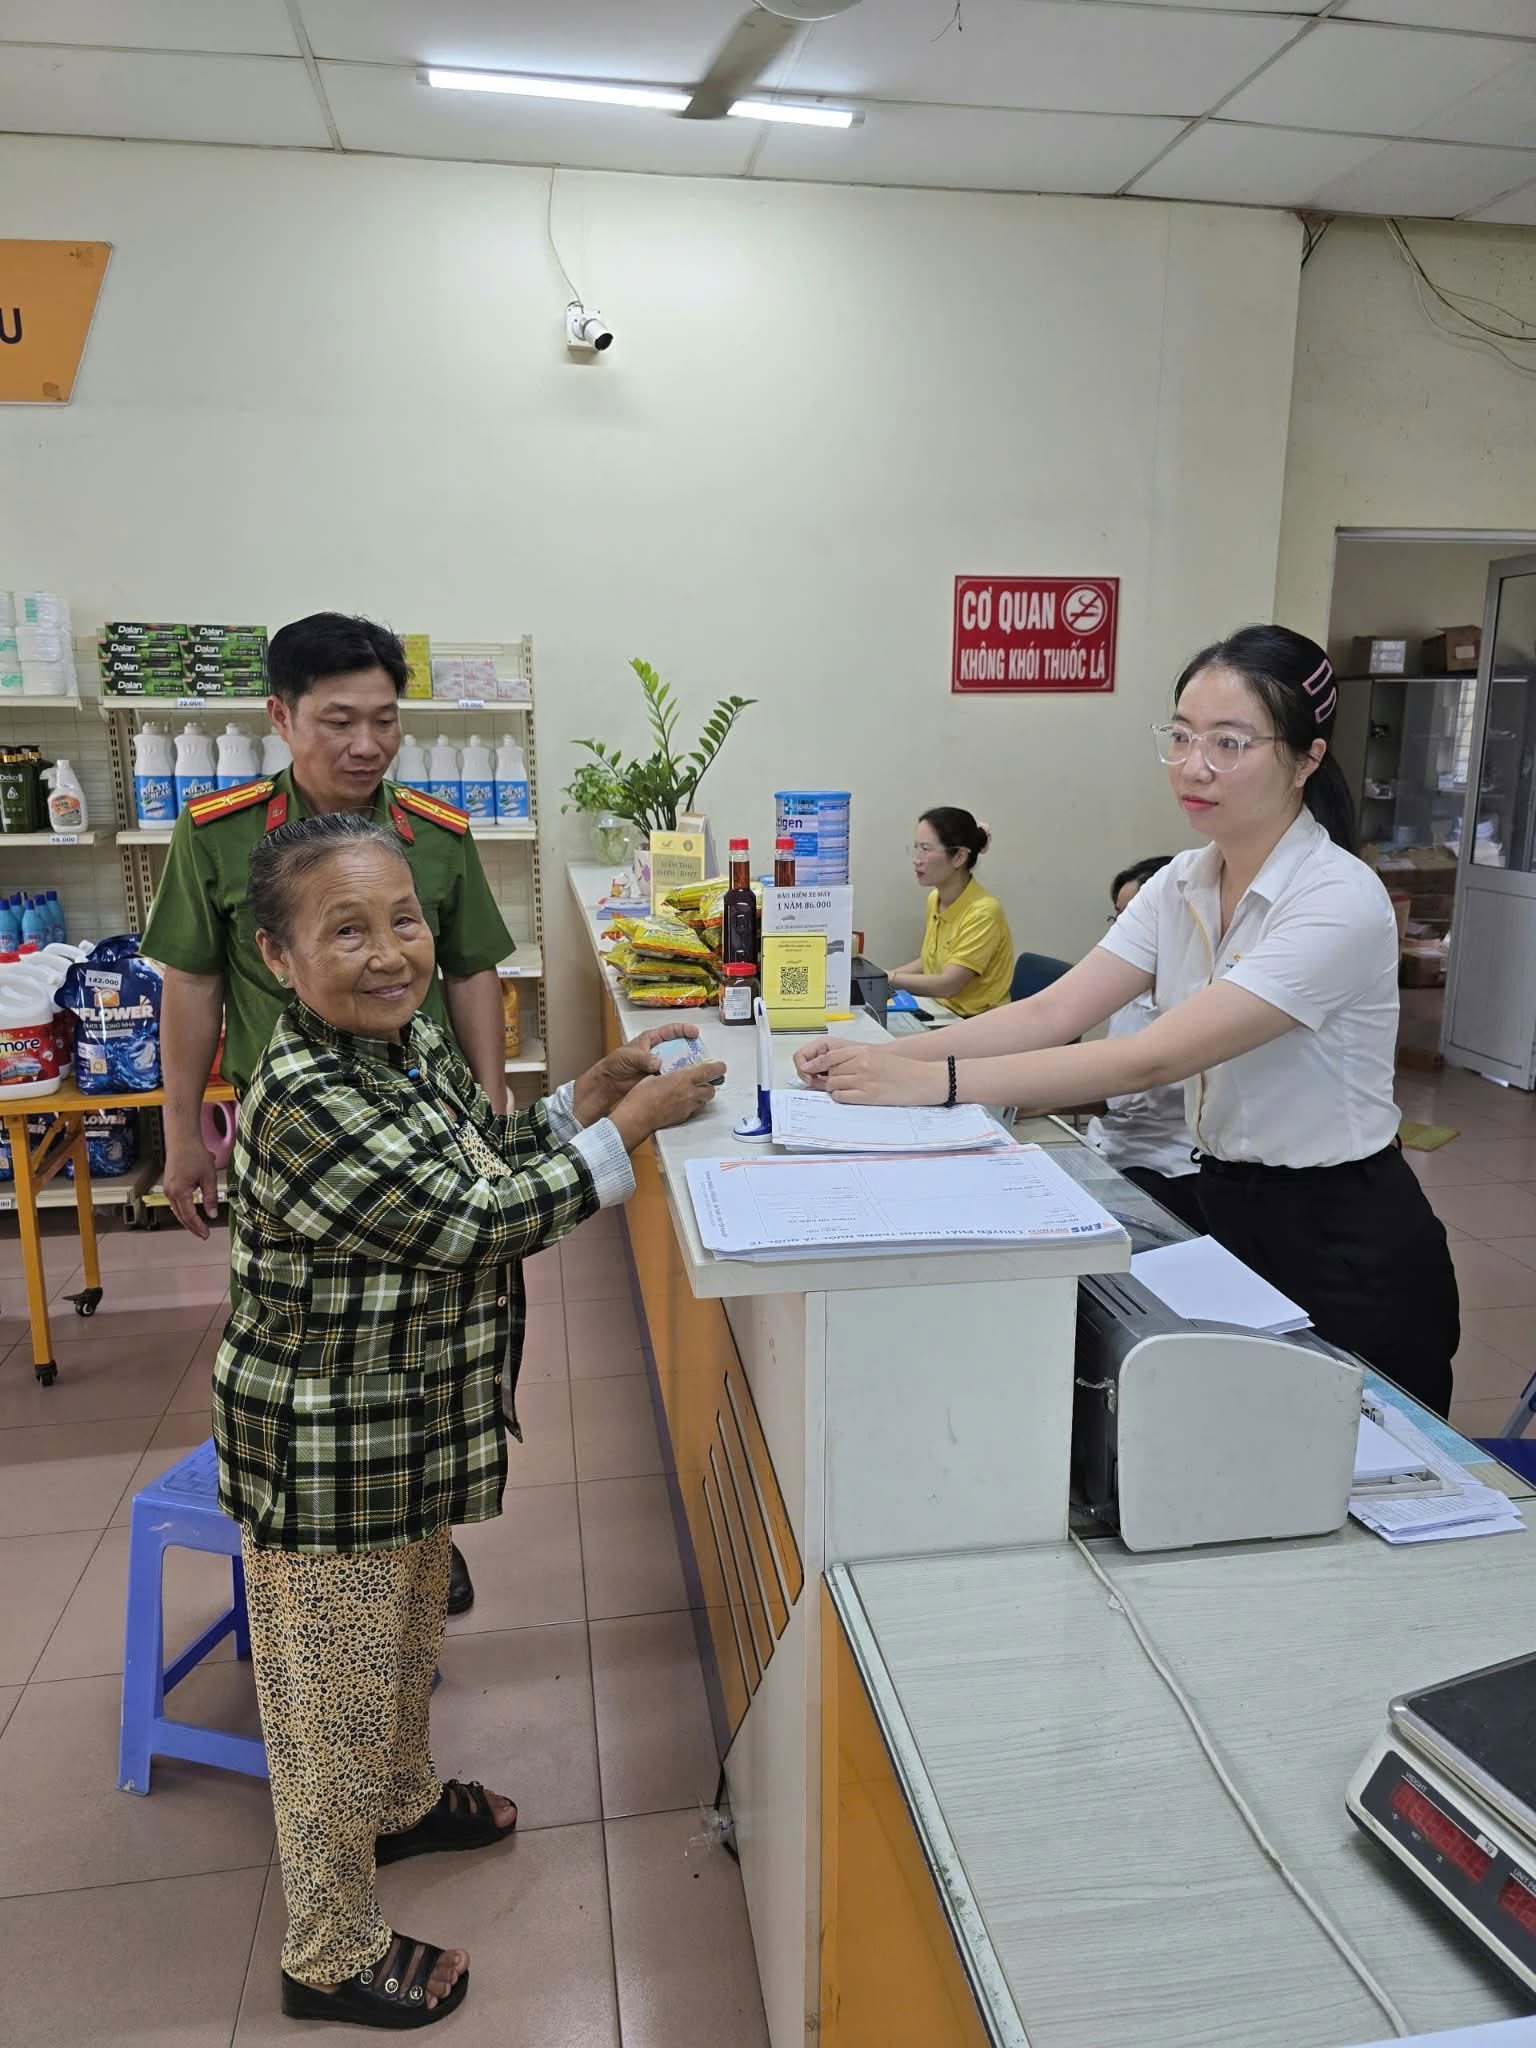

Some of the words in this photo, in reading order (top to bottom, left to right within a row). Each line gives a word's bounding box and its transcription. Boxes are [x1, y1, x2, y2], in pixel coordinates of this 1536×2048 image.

[962, 586, 993, 631] CƠ
[998, 591, 1056, 635] QUAN
[118, 625, 143, 634] Dalan
[199, 627, 224, 636] Dalan
[110, 643, 136, 652] Dalan
[194, 644, 219, 653] Dalan
[960, 640, 1005, 681] KHÔNG
[1008, 640, 1040, 681] KHÓI
[1044, 639, 1087, 681] THUỐC
[1089, 640, 1106, 680] LÁ
[114, 662, 139, 671] Dalan
[195, 663, 219, 672] Dalan
[118, 680, 143, 690] Dalan
[196, 681, 221, 690] Dalan
[81, 1006, 154, 1021] FLOWER
[1070, 1222, 1103, 1234] EMS
[1405, 1771, 1428, 1792] WEIGHT
